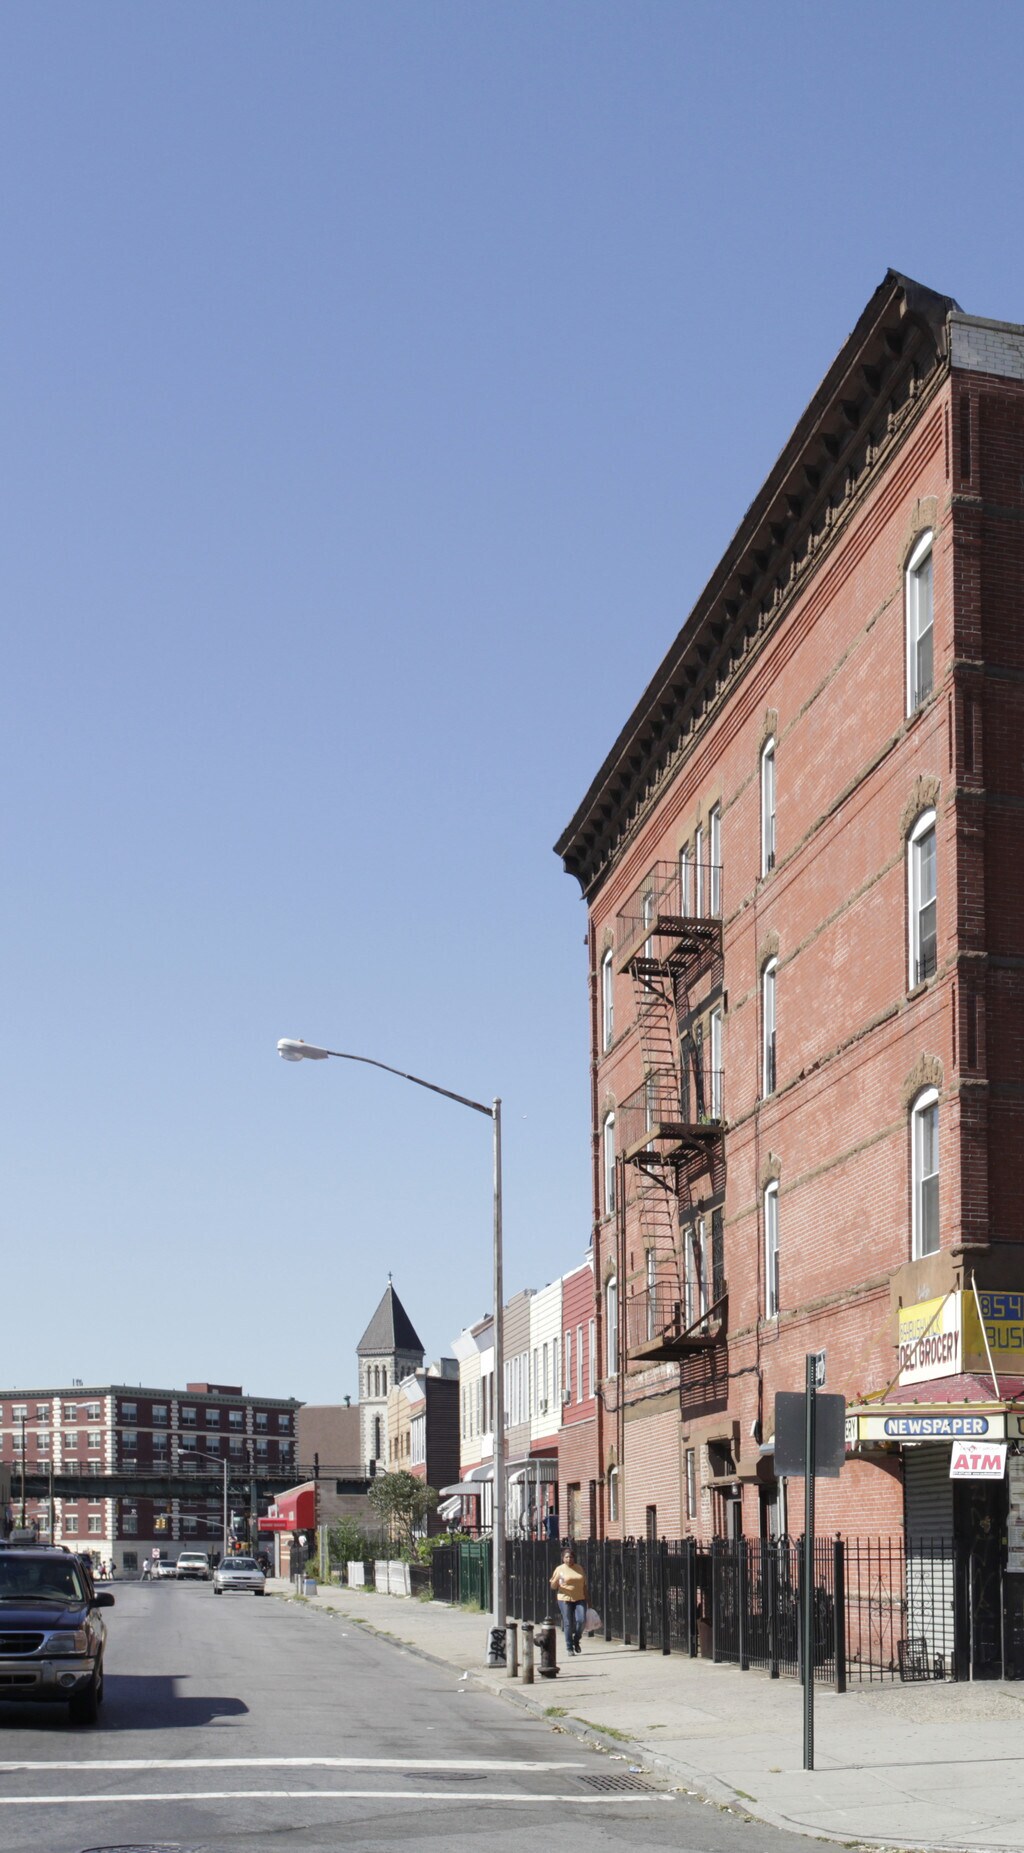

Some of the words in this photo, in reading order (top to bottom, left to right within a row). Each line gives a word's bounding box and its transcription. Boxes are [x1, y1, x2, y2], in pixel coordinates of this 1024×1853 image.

[980, 1295, 1021, 1318] 854
[919, 1330, 959, 1368] GROCERY
[888, 1419, 983, 1434] NEWSPAPER
[953, 1454, 1001, 1470] ATM
